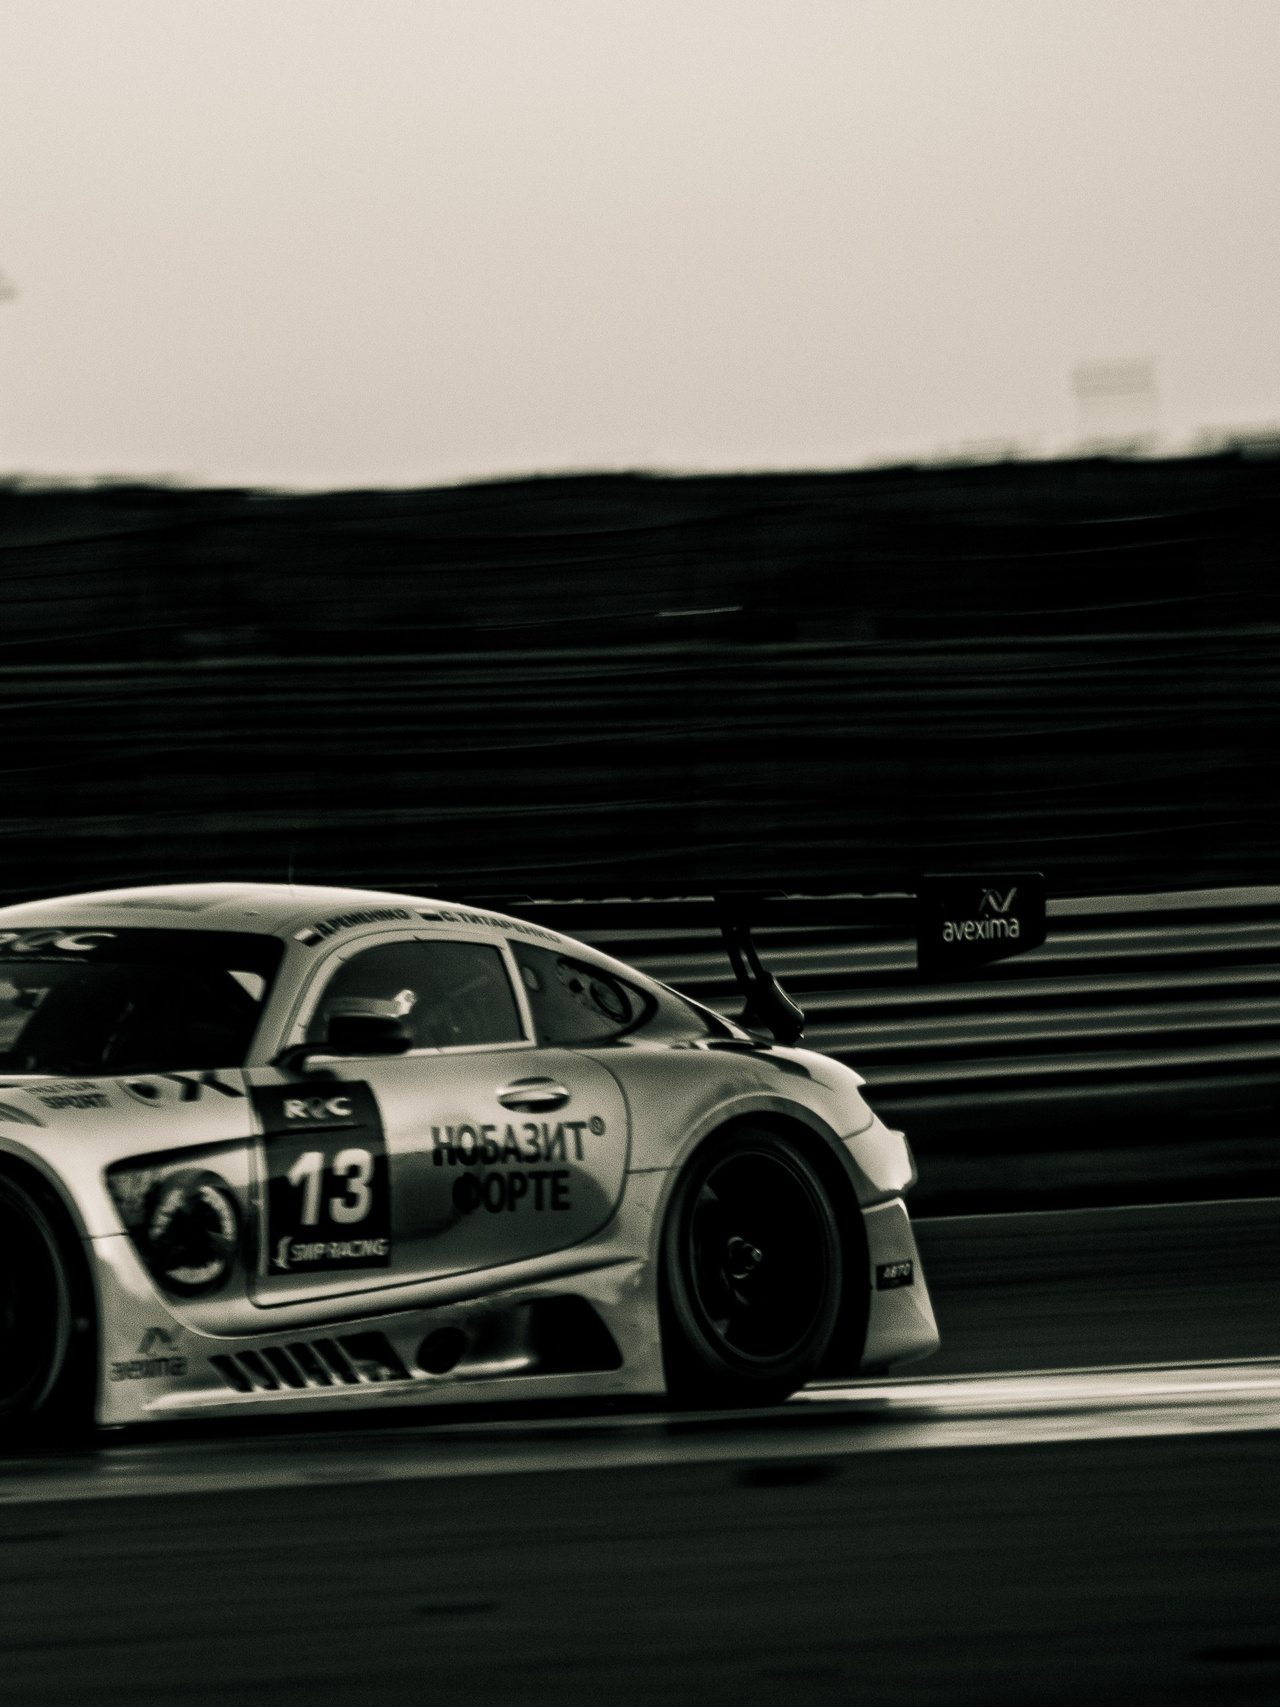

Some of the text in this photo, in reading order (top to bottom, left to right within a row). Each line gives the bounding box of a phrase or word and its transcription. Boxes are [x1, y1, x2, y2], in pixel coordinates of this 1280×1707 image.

[941, 912, 1020, 942] avexima
[287, 1148, 373, 1227] 13
[452, 1170, 570, 1215] ФОРТЕ
[290, 1239, 390, 1262] SMP RACING
